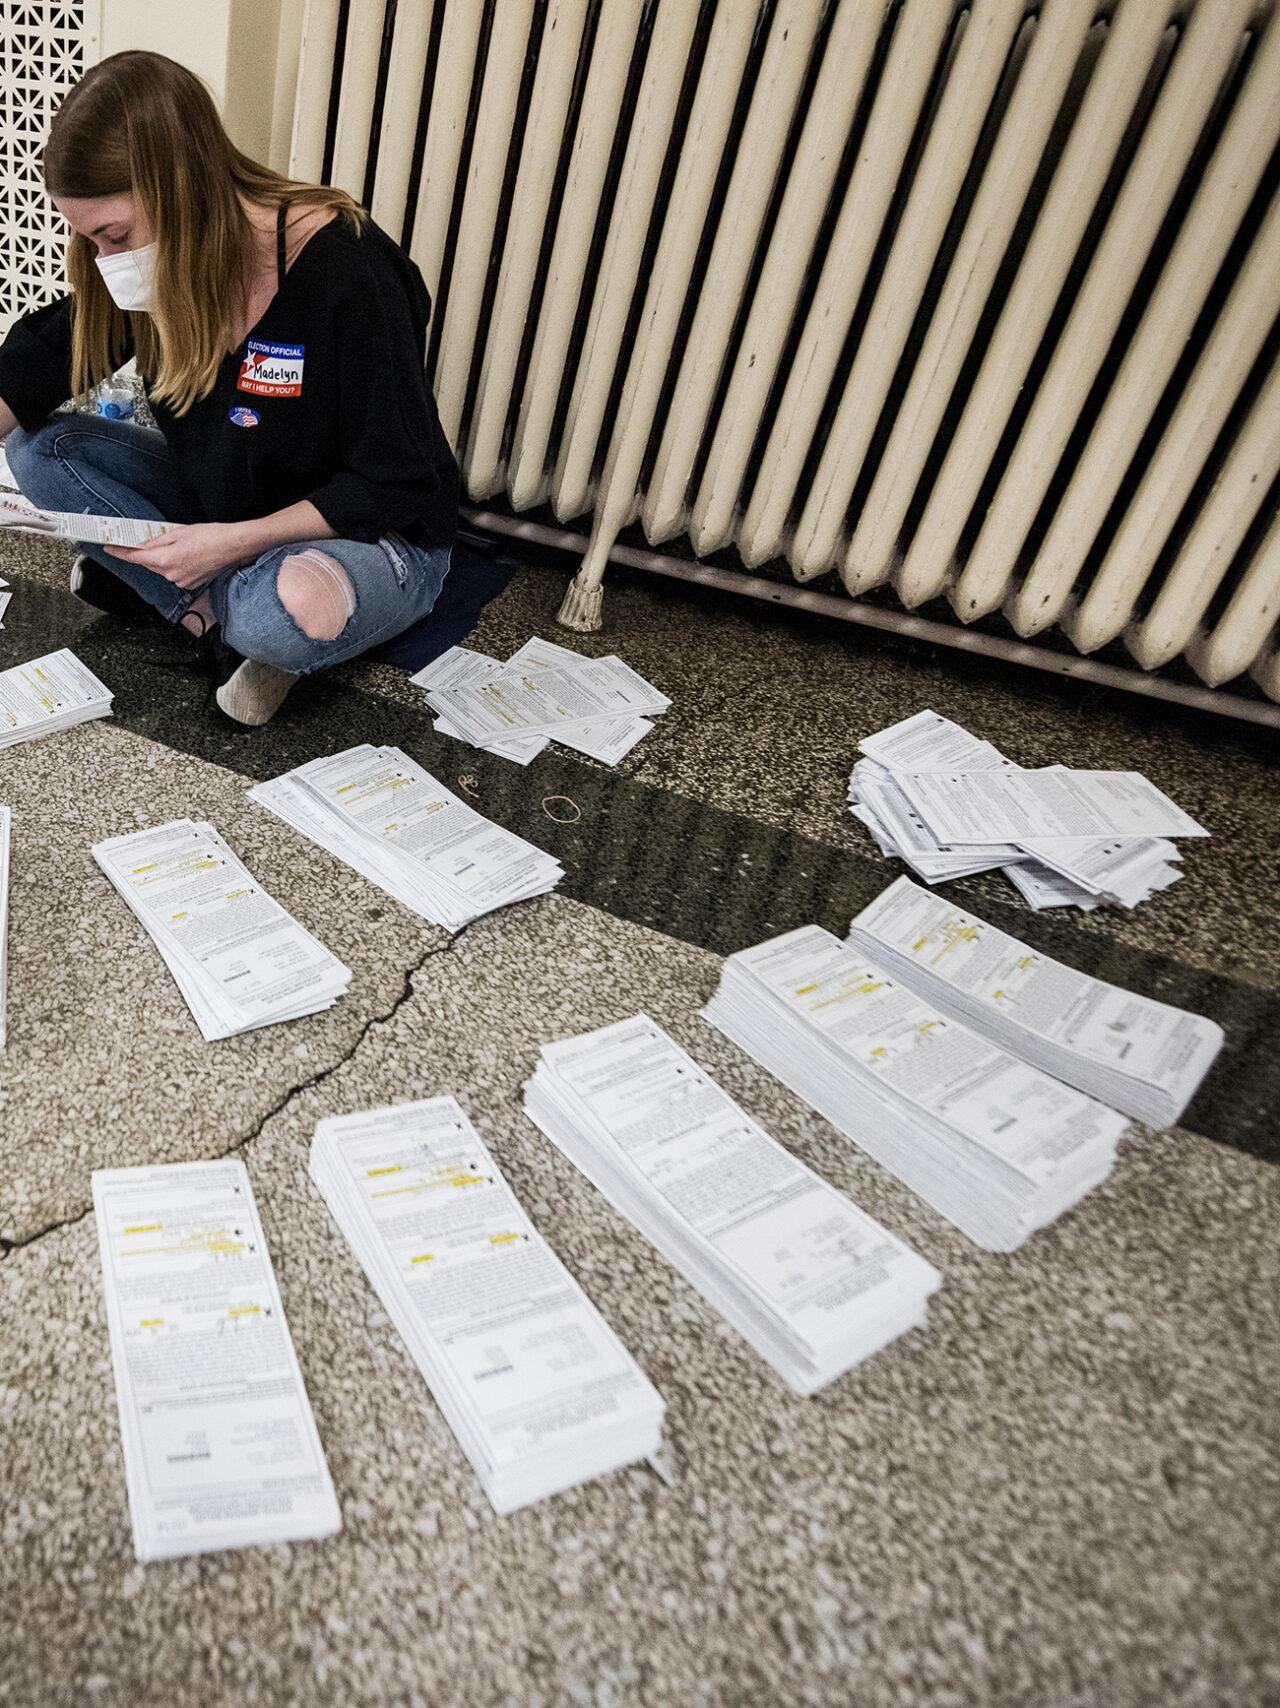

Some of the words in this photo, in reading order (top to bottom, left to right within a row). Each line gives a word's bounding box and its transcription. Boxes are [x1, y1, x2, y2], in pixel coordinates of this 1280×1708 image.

[248, 341, 270, 354] ELECTION
[271, 346, 302, 356] OFFICIAL
[253, 365, 298, 383] Madelyn
[241, 381, 252, 389] MAY
[256, 384, 275, 393] HELP
[275, 386, 295, 394] YOU?
